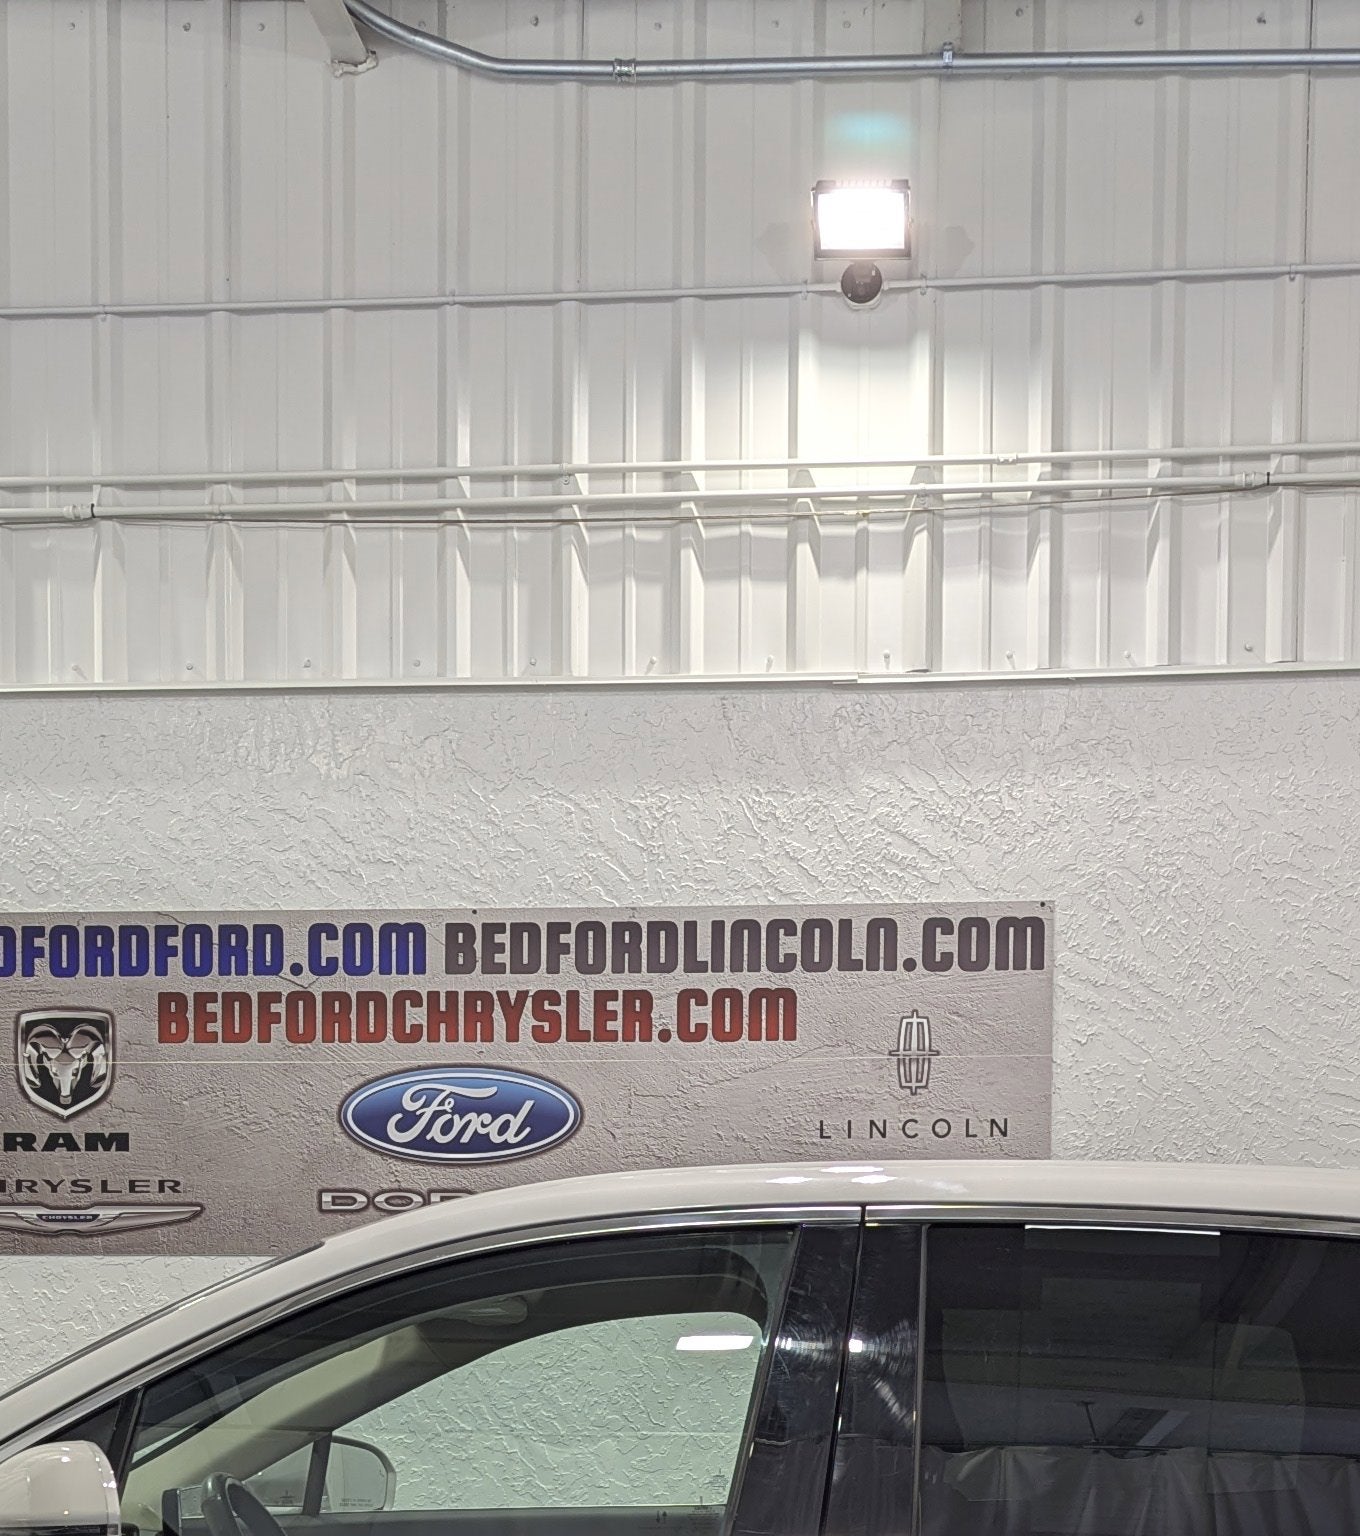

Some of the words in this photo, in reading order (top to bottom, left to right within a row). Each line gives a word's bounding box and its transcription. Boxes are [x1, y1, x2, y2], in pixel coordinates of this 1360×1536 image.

[444, 916, 1045, 975] BEDFORDLINCOLN.COM
[157, 987, 797, 1044] BEDFORDCHRYSLER.COM
[3, 1132, 129, 1152] RAM
[386, 1083, 534, 1144] Ford
[819, 1118, 1008, 1139] LINCOLN
